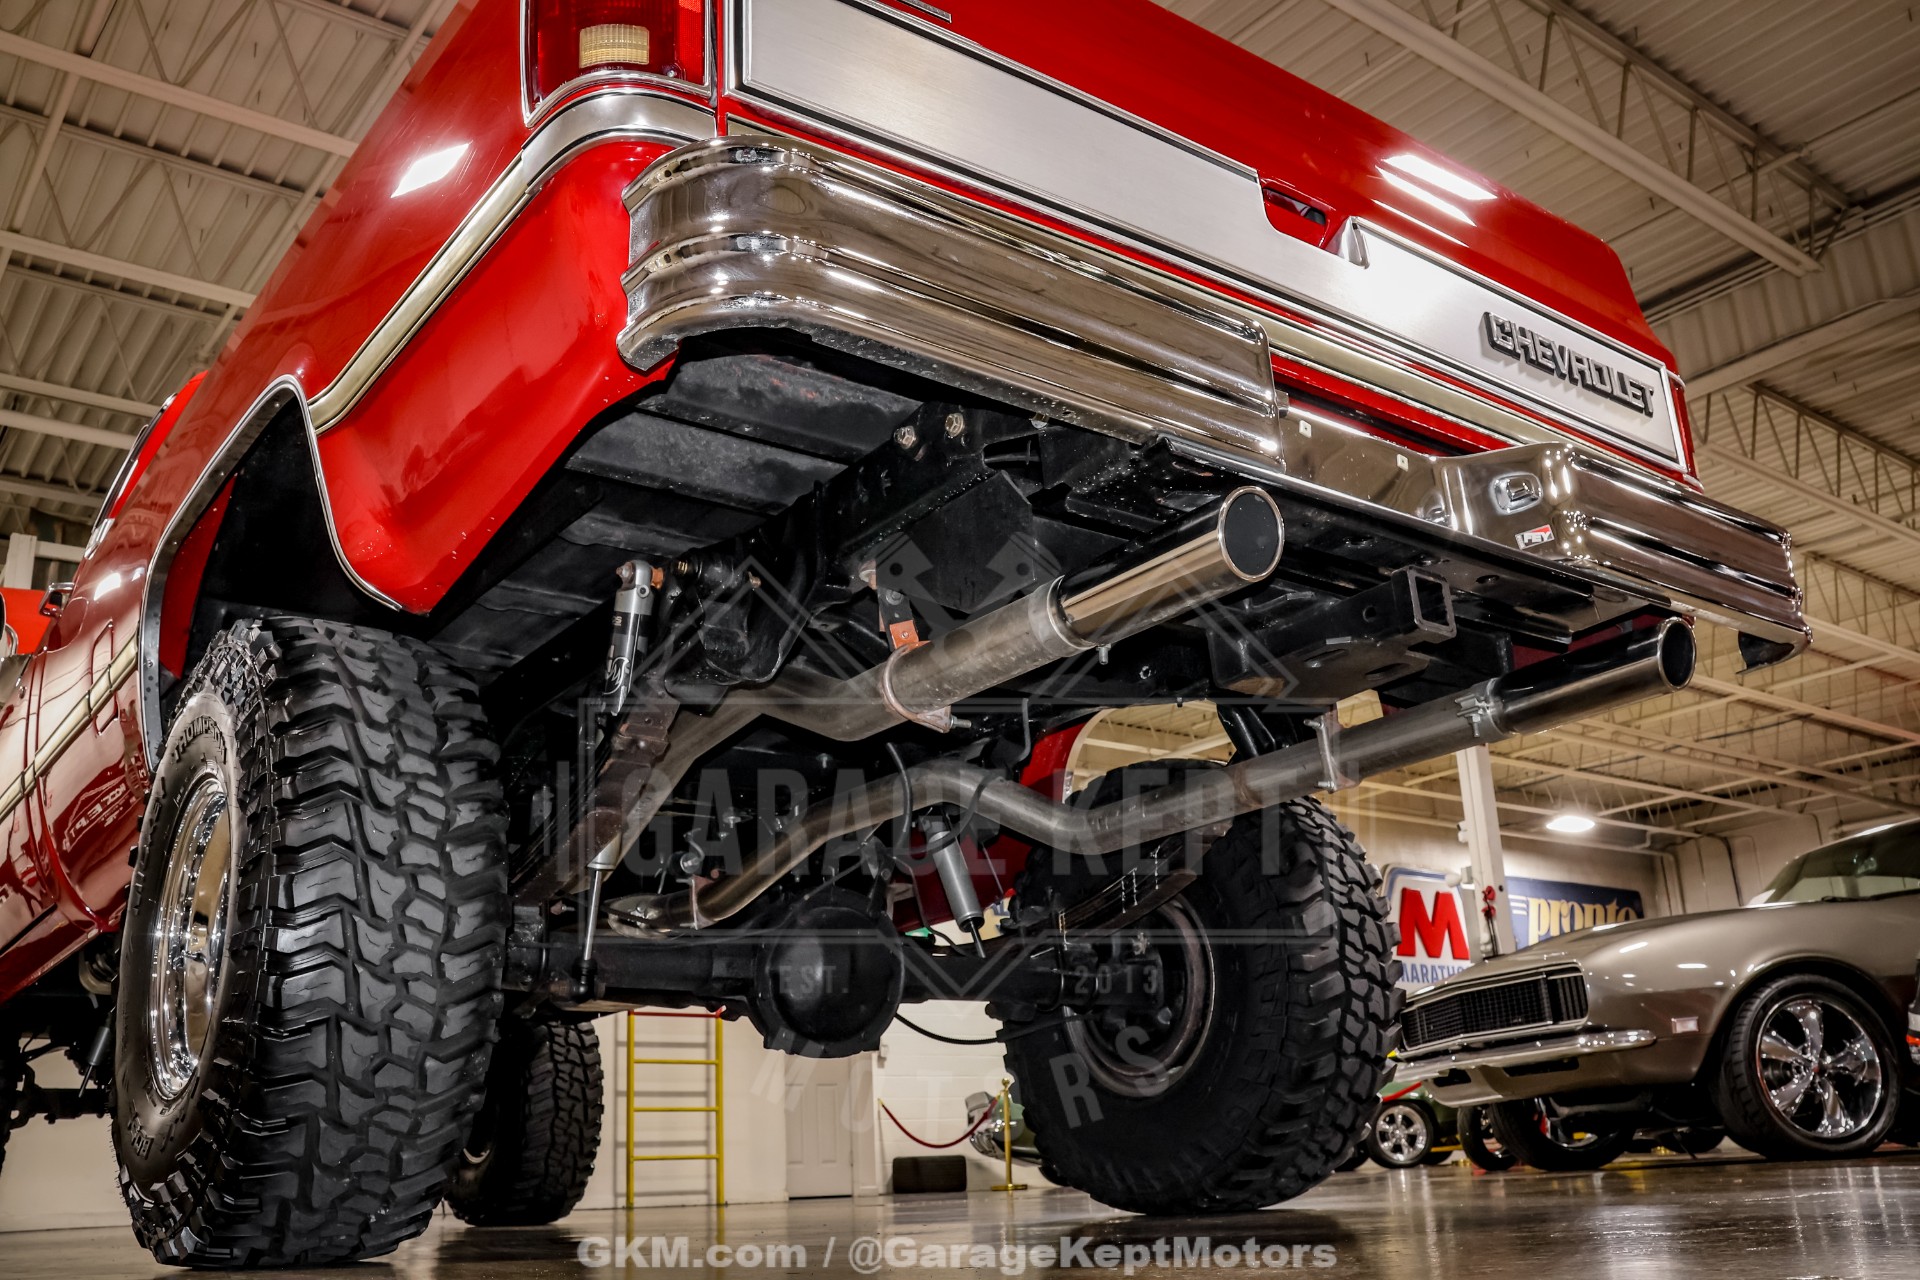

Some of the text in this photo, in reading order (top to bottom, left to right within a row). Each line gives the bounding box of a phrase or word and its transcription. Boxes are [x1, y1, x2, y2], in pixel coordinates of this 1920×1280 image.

[1484, 311, 1654, 418] CHEVROLET
[1522, 531, 1551, 544] FEY
[1396, 887, 1470, 960] M
